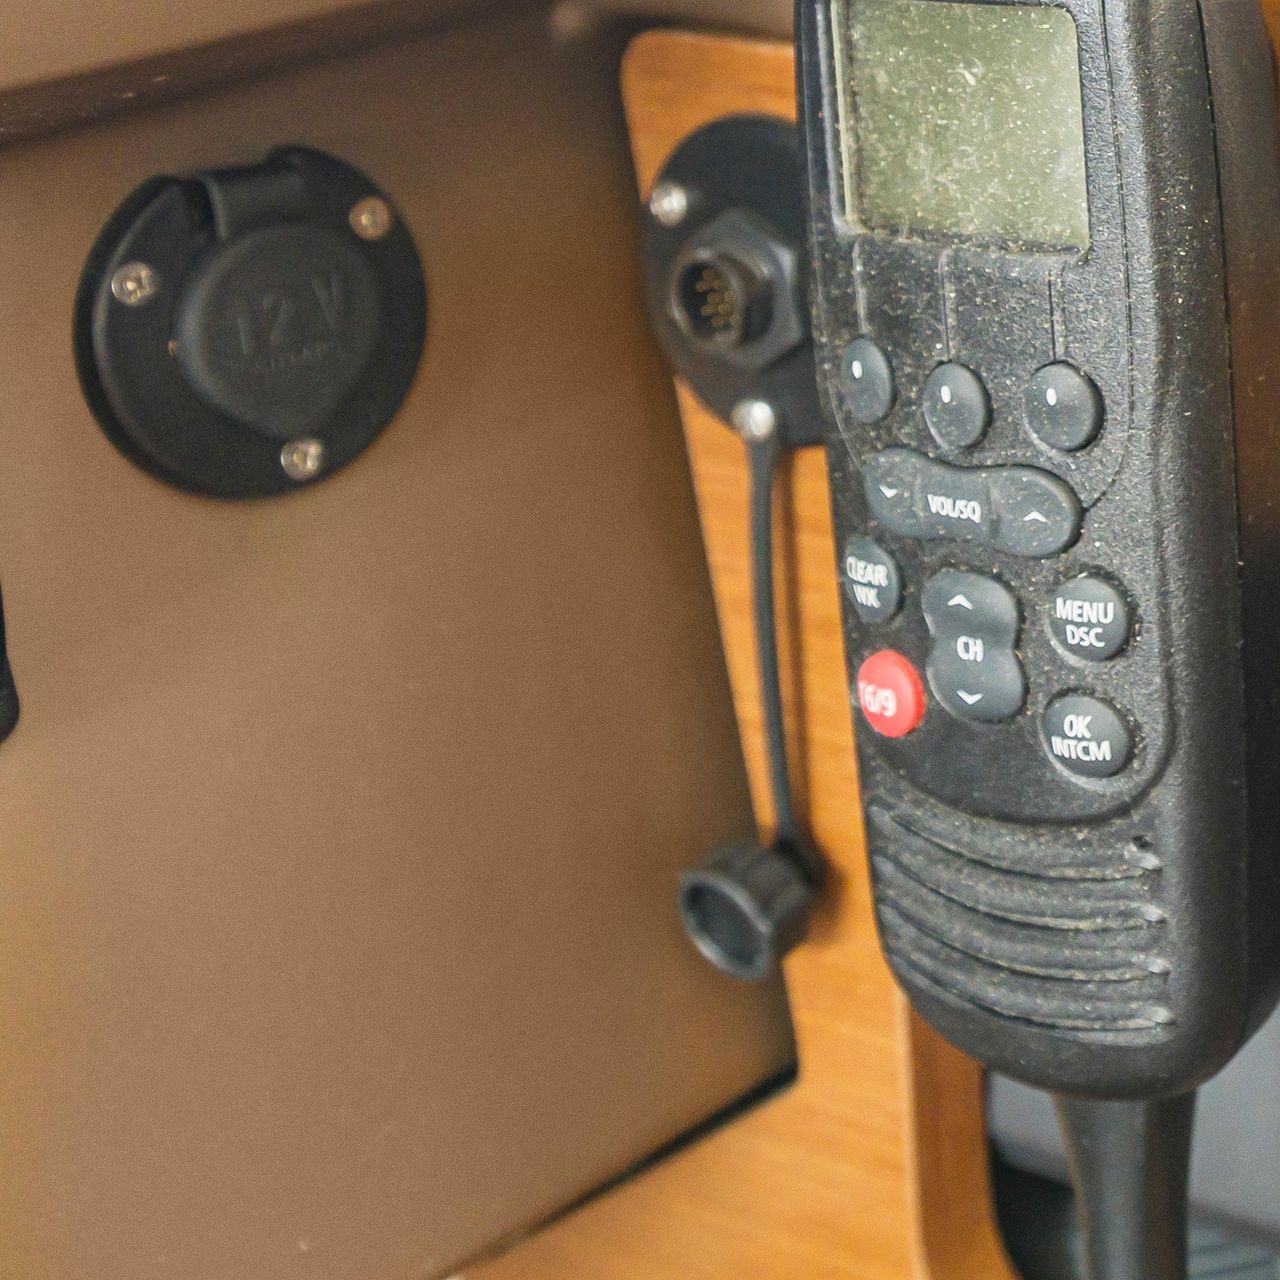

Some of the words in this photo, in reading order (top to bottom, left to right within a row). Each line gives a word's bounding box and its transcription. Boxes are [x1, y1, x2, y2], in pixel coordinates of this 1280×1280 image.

[846, 555, 889, 588] CLEAR
[1055, 596, 1115, 624] MENU
[956, 635, 984, 662] CH
[1065, 623, 1106, 648] DSC
[1063, 713, 1093, 738] OK
[1051, 736, 1112, 762] INTCM
